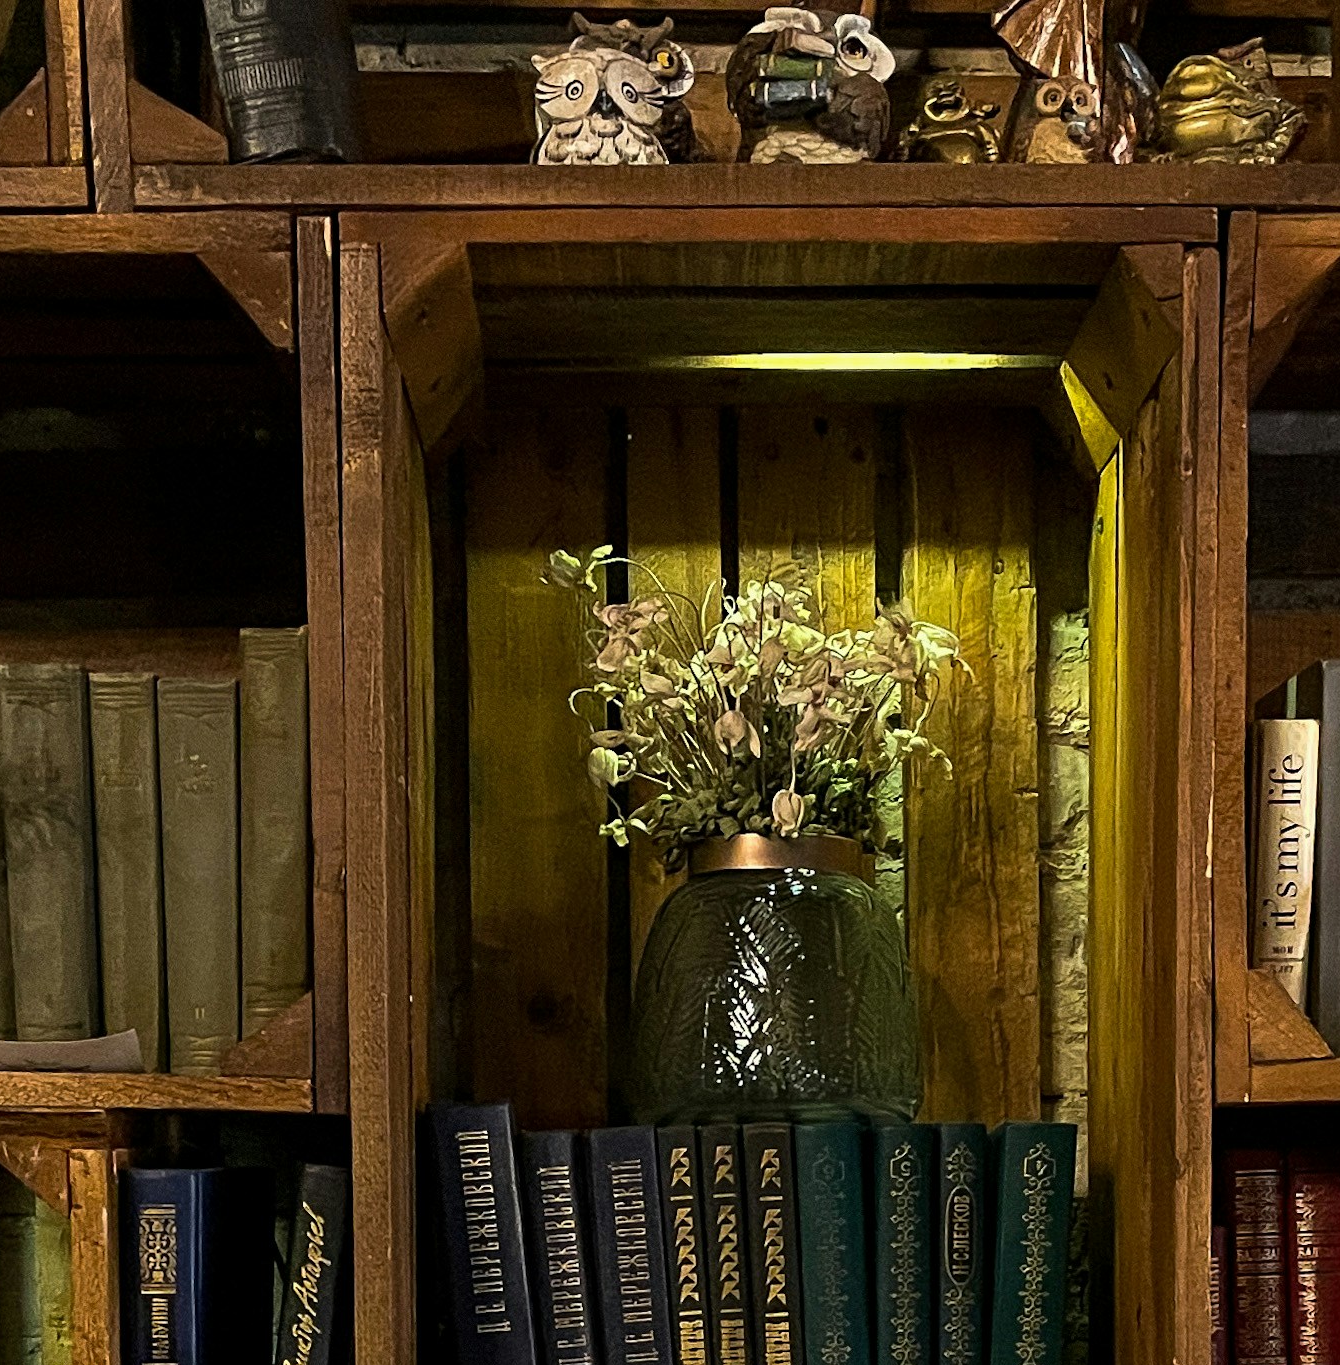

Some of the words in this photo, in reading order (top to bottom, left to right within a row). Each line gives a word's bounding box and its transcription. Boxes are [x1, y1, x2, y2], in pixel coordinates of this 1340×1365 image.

[1267, 753, 1305, 806] life
[1276, 814, 1311, 874] my
[1262, 881, 1299, 929] it's
